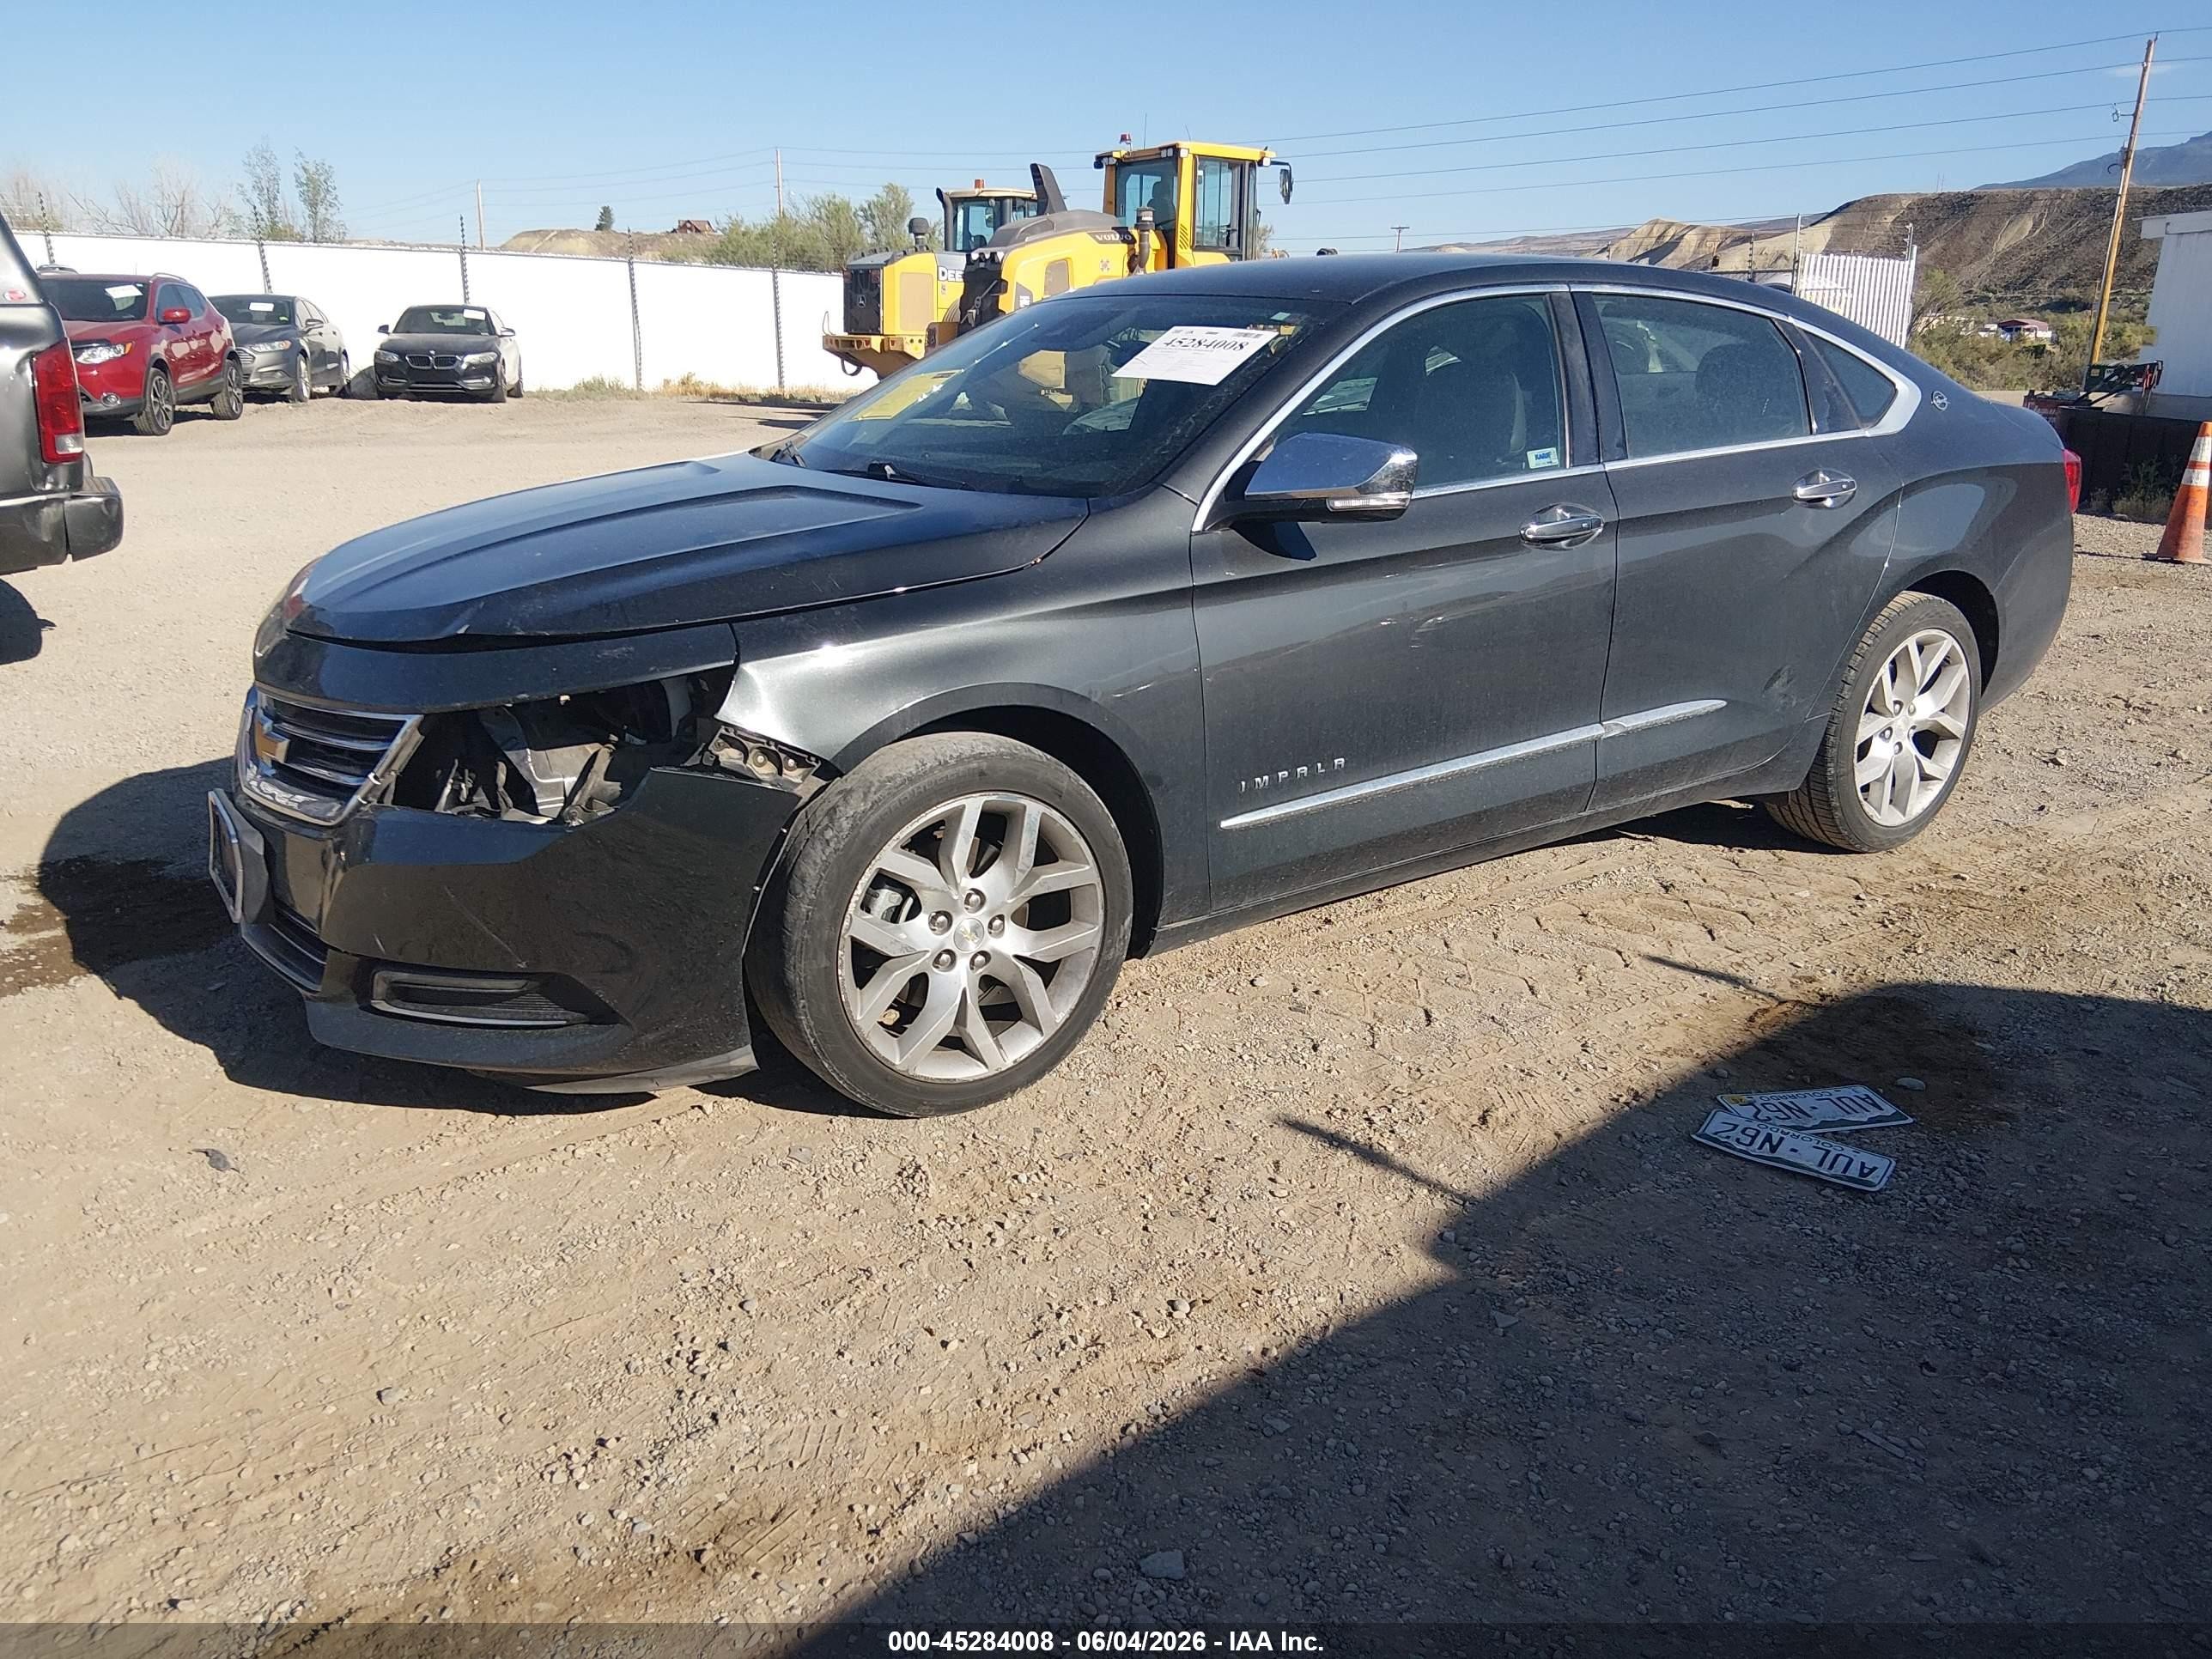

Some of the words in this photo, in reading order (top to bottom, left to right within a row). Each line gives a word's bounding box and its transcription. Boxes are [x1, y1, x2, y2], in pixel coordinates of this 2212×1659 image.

[1164, 337, 1249, 351] 45284008
[1240, 757, 1346, 792] IMPALA
[1759, 1091, 1832, 1101] COLORADO
[1757, 1123, 1845, 1152] COLORADO
